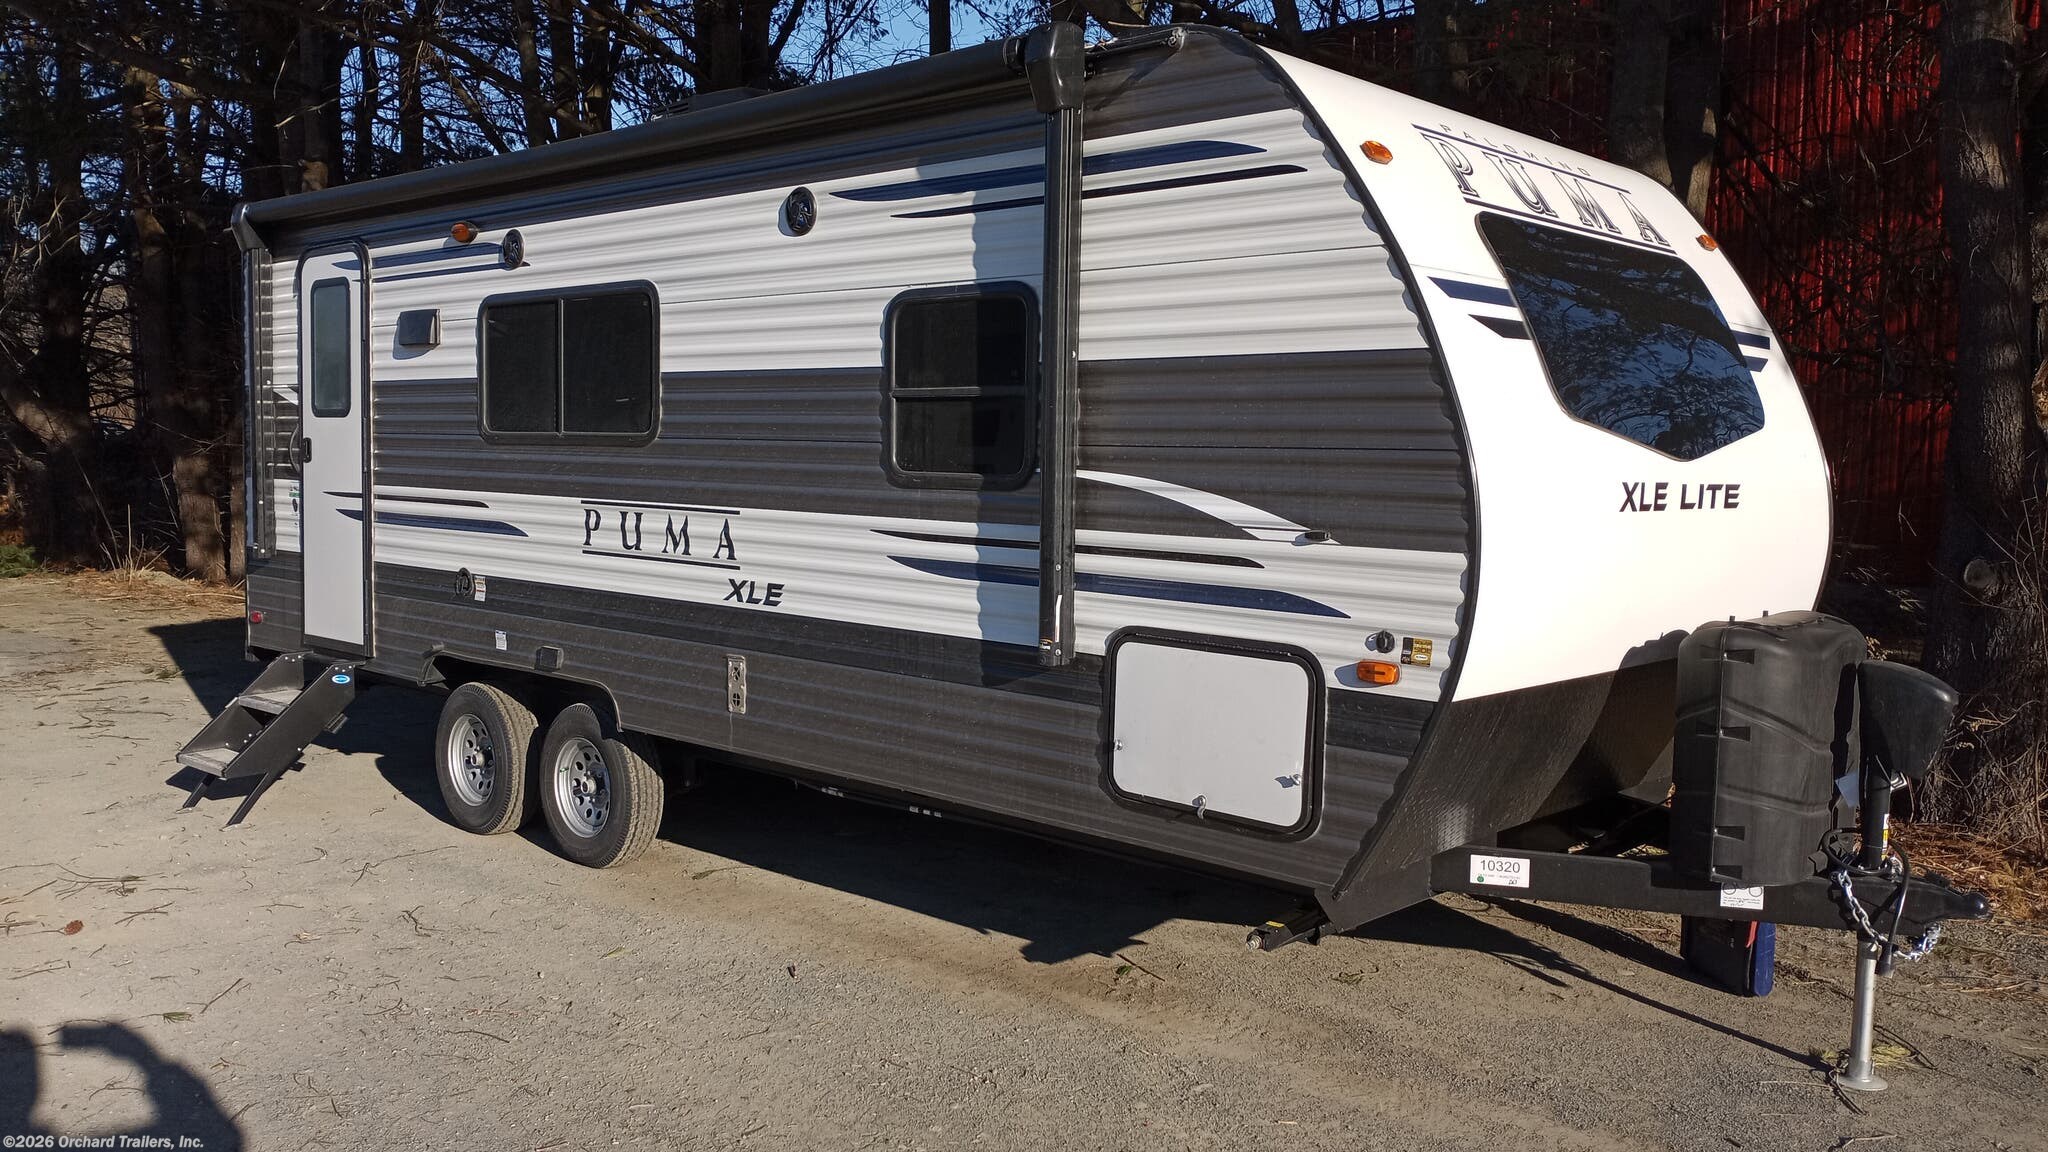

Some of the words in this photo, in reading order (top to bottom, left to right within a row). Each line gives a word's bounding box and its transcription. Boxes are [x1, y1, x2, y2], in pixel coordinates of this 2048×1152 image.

[1439, 124, 1591, 176] PALOMINO
[1420, 132, 1671, 248] PUMA
[1619, 481, 1669, 512] XLE
[1680, 483, 1741, 510] LITE
[583, 508, 738, 561] PUMA
[723, 578, 785, 607] XLE
[1480, 859, 1521, 873] 10320
